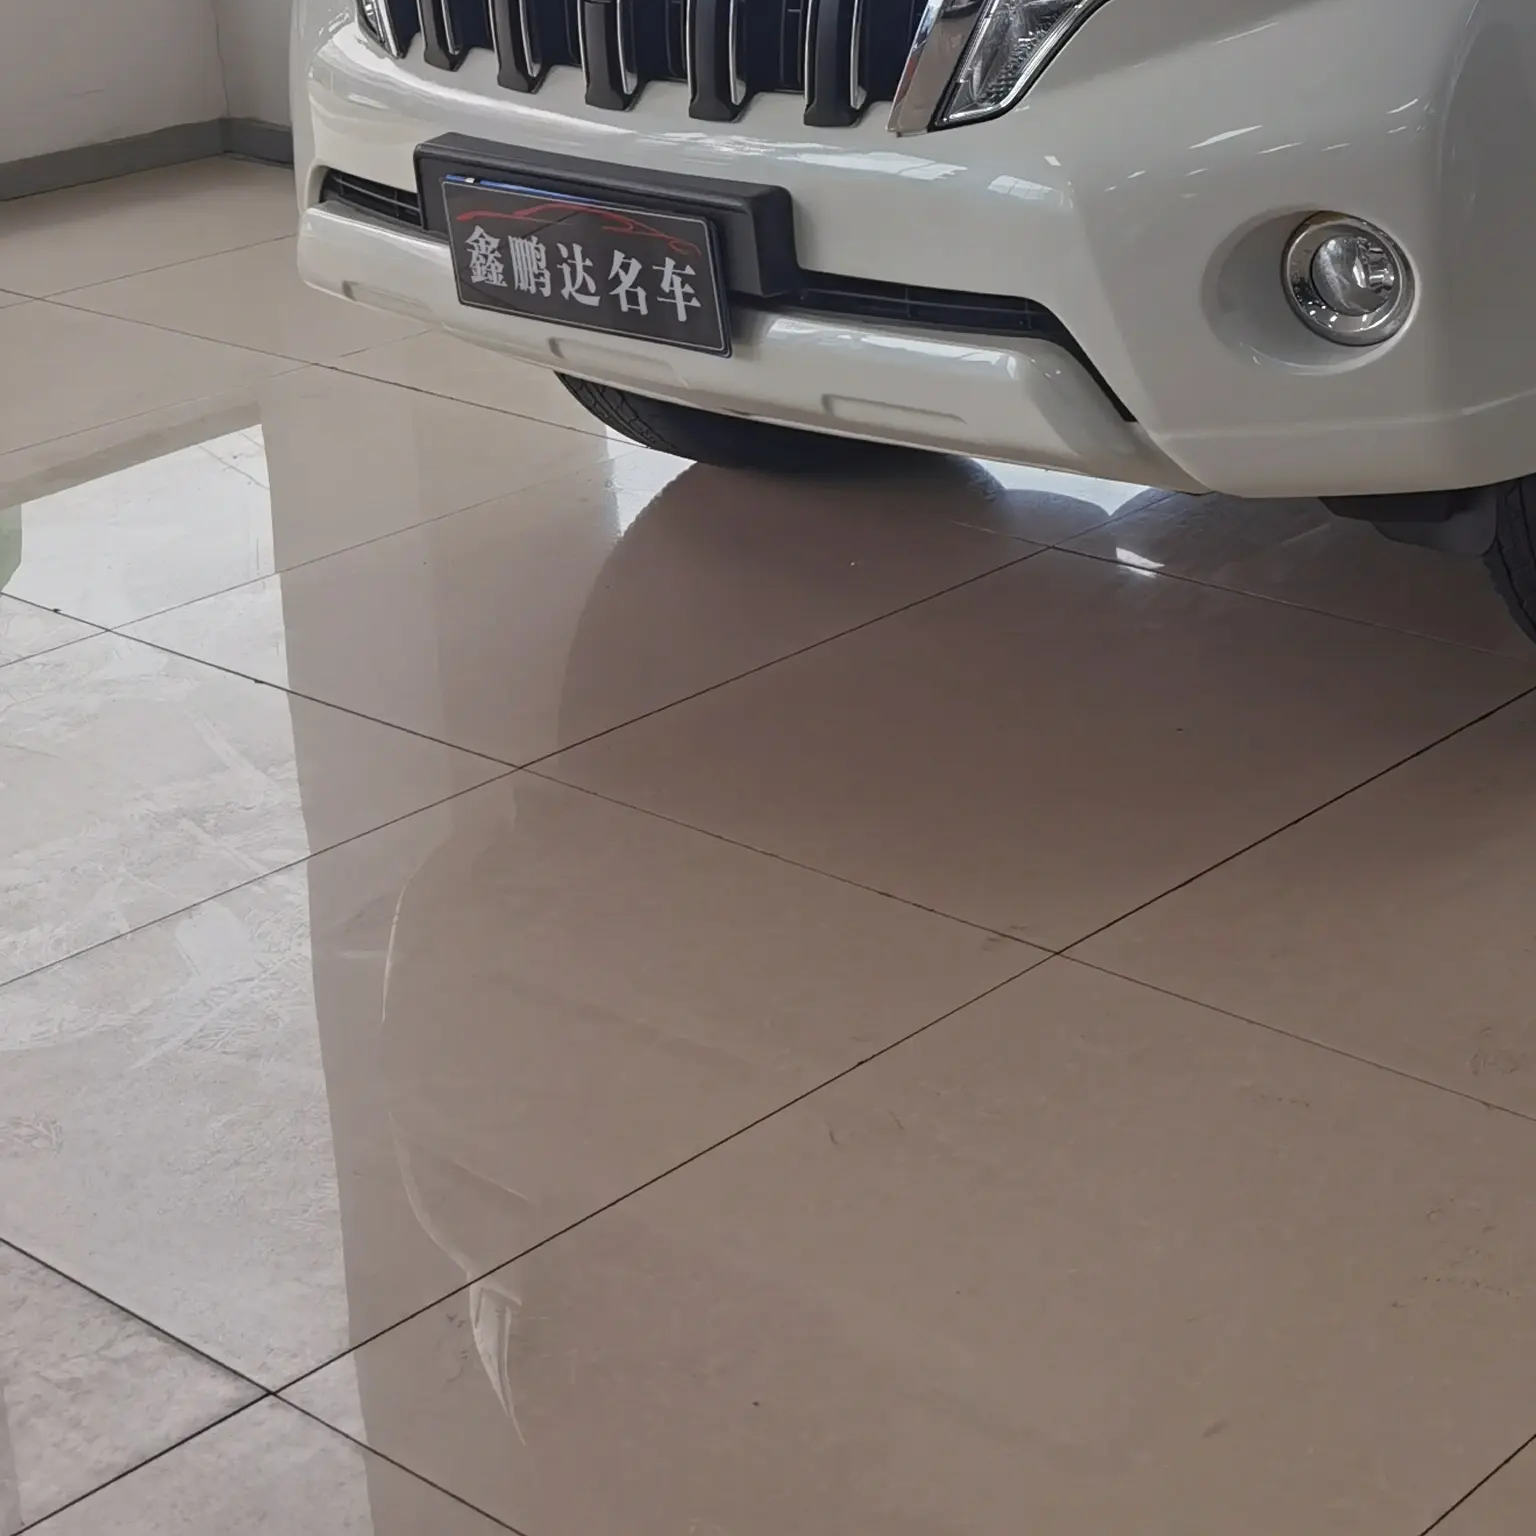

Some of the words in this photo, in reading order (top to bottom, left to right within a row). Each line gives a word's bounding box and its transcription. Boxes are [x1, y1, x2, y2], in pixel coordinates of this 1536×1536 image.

[465, 224, 702, 323] 鑫鹏达名车
